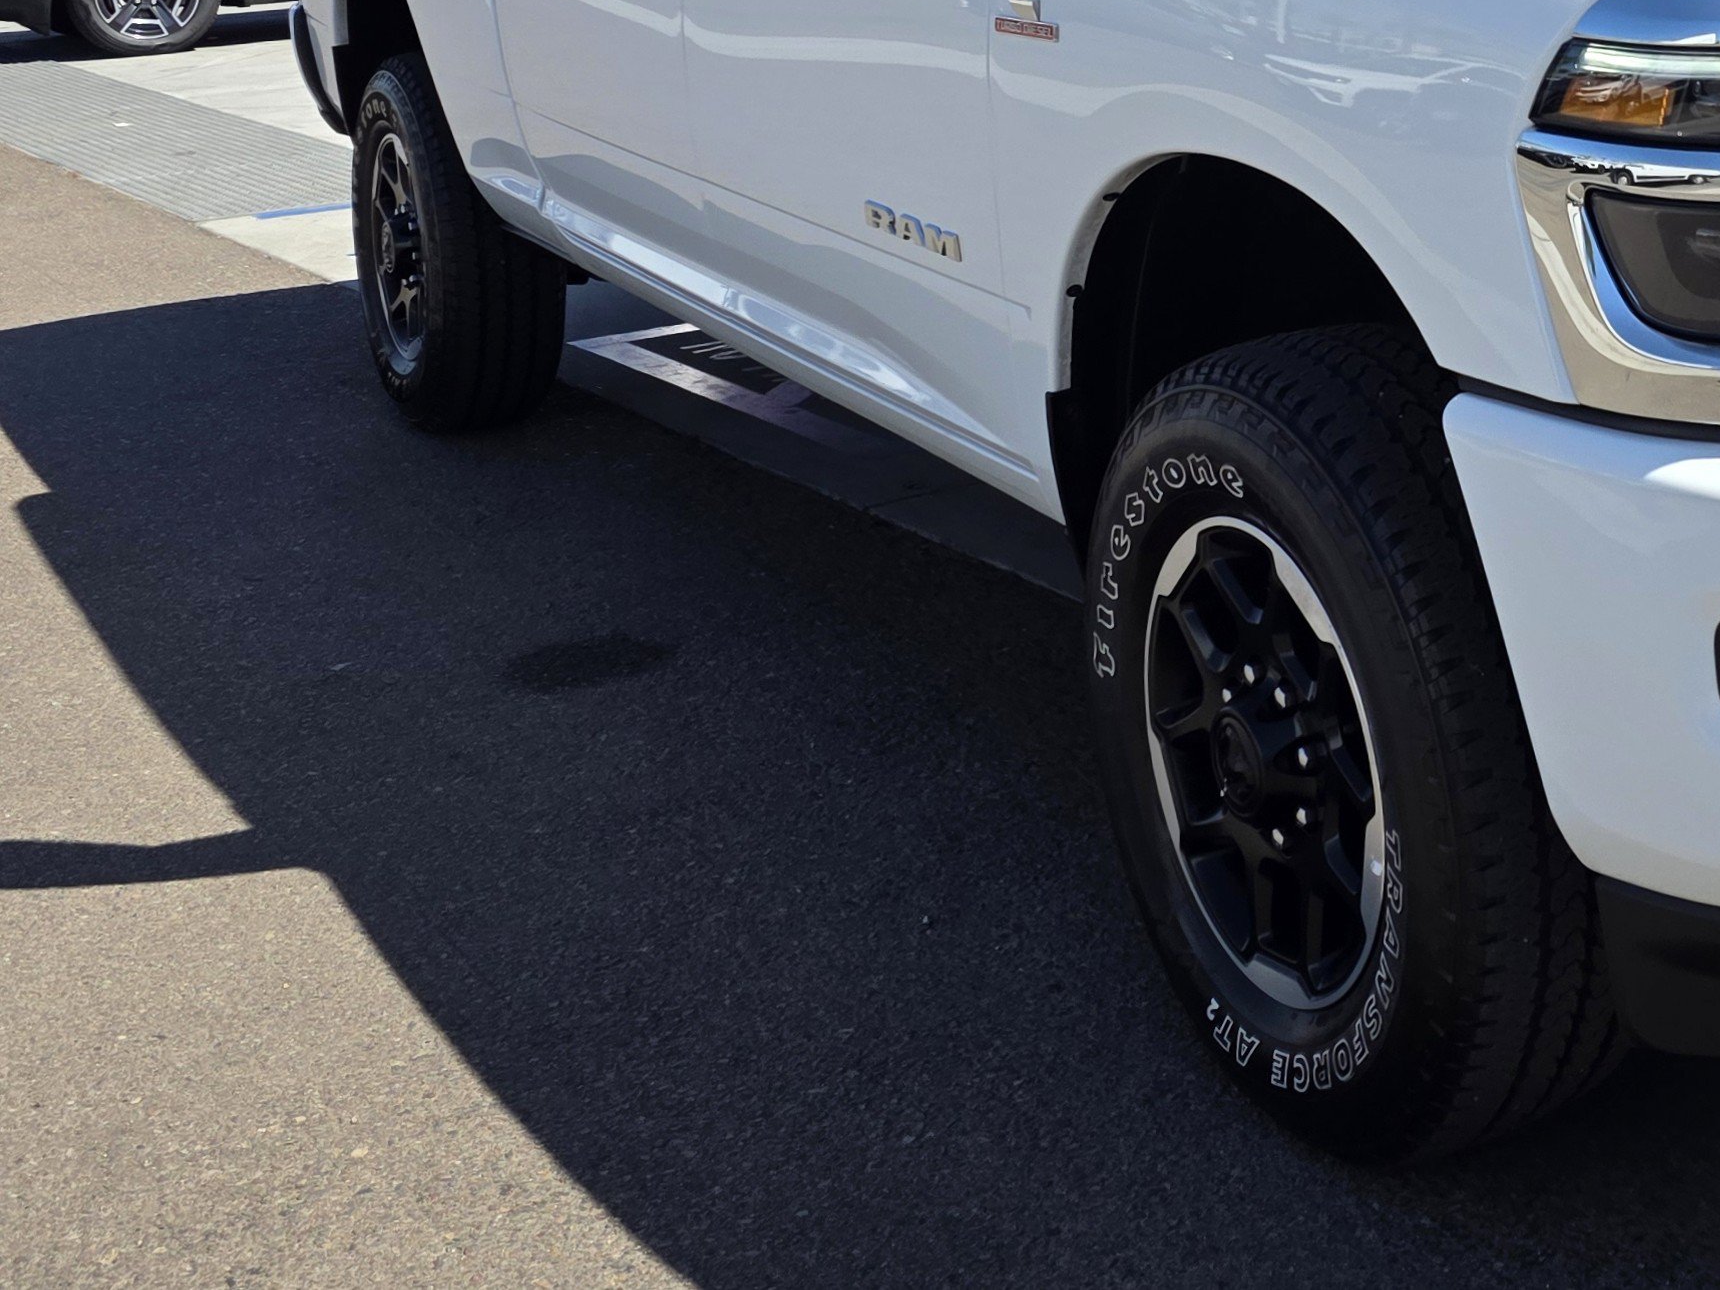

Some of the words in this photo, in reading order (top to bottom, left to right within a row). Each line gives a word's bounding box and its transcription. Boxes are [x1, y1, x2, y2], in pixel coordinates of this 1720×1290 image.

[864, 199, 962, 262] RAM
[1093, 453, 1244, 678] Firestone
[1271, 828, 1404, 1093] TRANSFORCE
